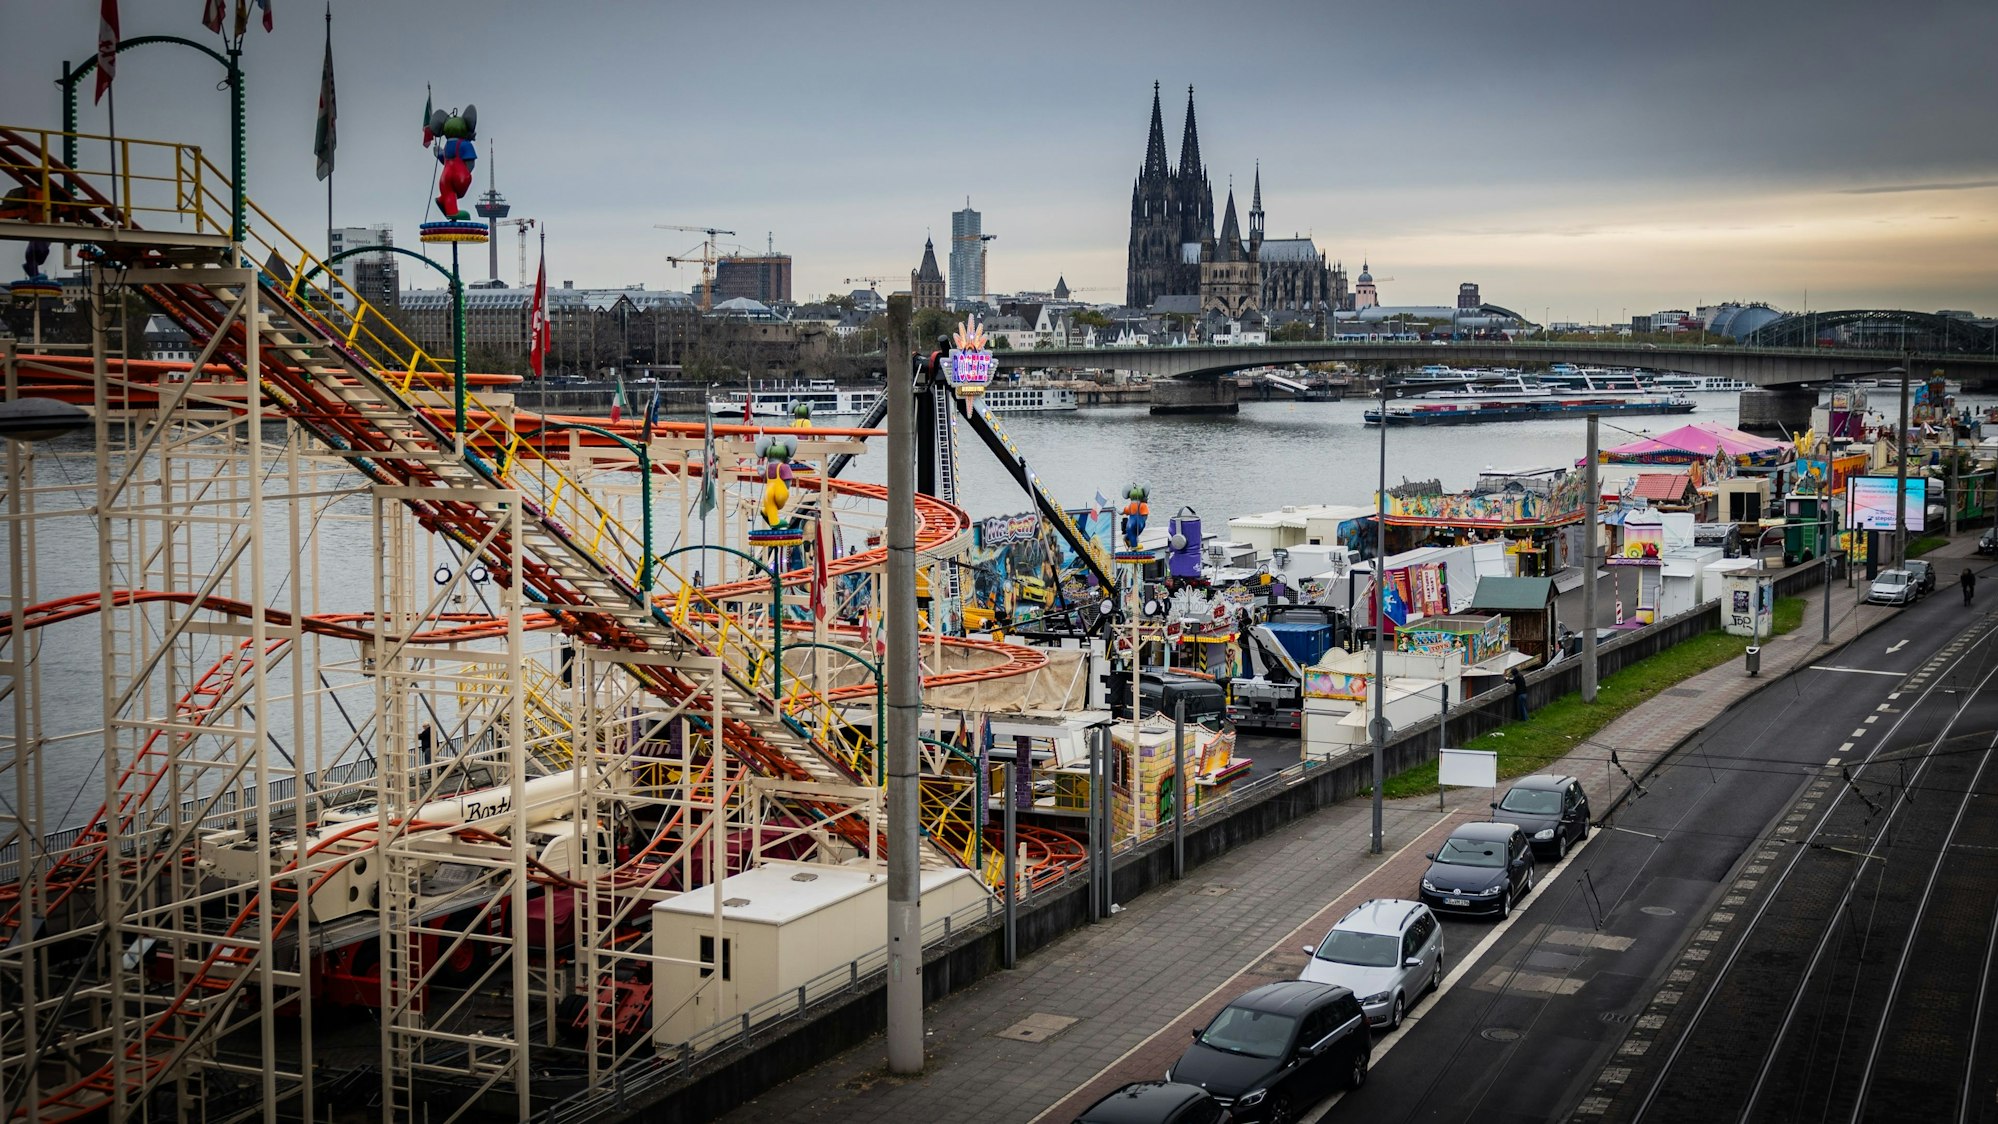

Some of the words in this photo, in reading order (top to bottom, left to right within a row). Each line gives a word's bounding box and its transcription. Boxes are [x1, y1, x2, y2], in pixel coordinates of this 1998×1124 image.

[952, 353, 991, 382] ROCKET
[1430, 641, 1450, 653] TOYS
[465, 796, 511, 823] Bart
